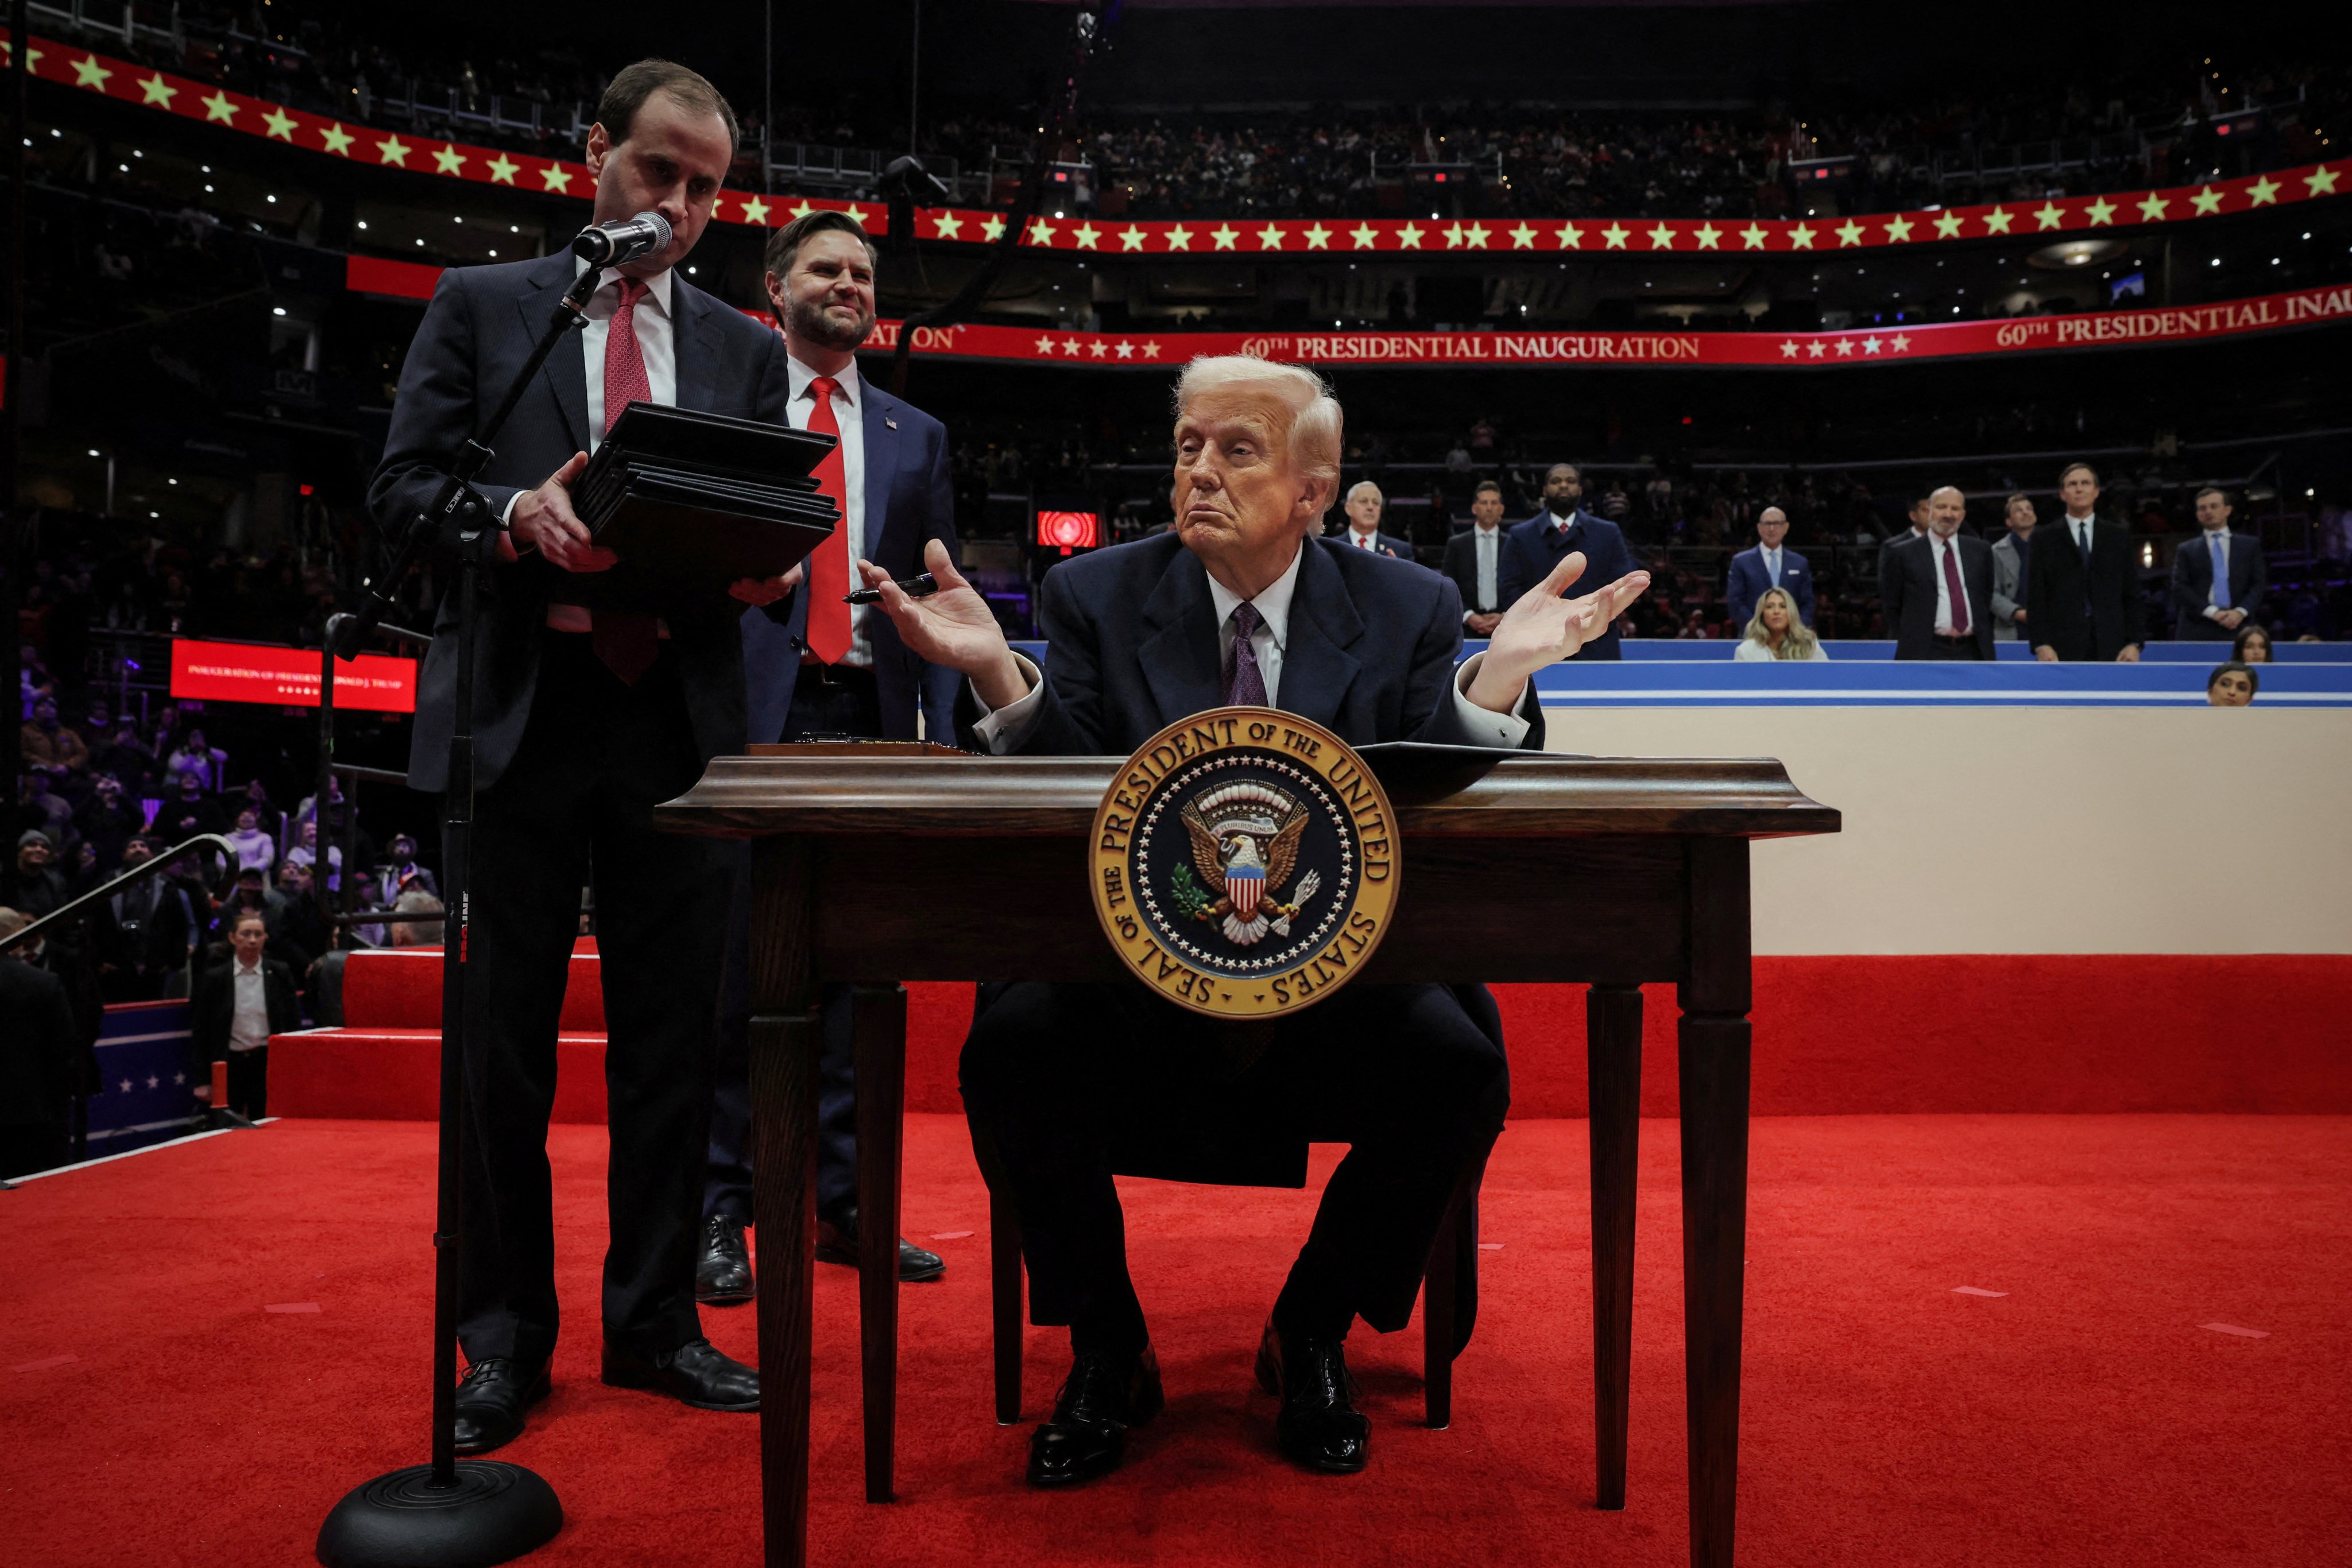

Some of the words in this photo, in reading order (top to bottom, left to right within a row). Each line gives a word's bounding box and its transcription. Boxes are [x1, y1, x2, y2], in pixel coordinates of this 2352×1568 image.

[1997, 321, 2049, 347] 60TH
[2057, 301, 2278, 342] PRESIDENTIAL
[1296, 336, 1489, 358] PRESIDENTIAL
[1495, 336, 1700, 359] INAUGURATION
[1248, 723, 1277, 741] OF
[1283, 729, 1321, 758] THE
[1101, 718, 1239, 852] PRESIDENT
[1220, 822, 1253, 831] PLURIBUS
[1328, 757, 1390, 881] UNITED
[1104, 866, 1127, 909] THE
[1115, 914, 1139, 940] OF
[1139, 938, 1215, 1002] SEAL
[1272, 911, 1375, 1004] STATES
